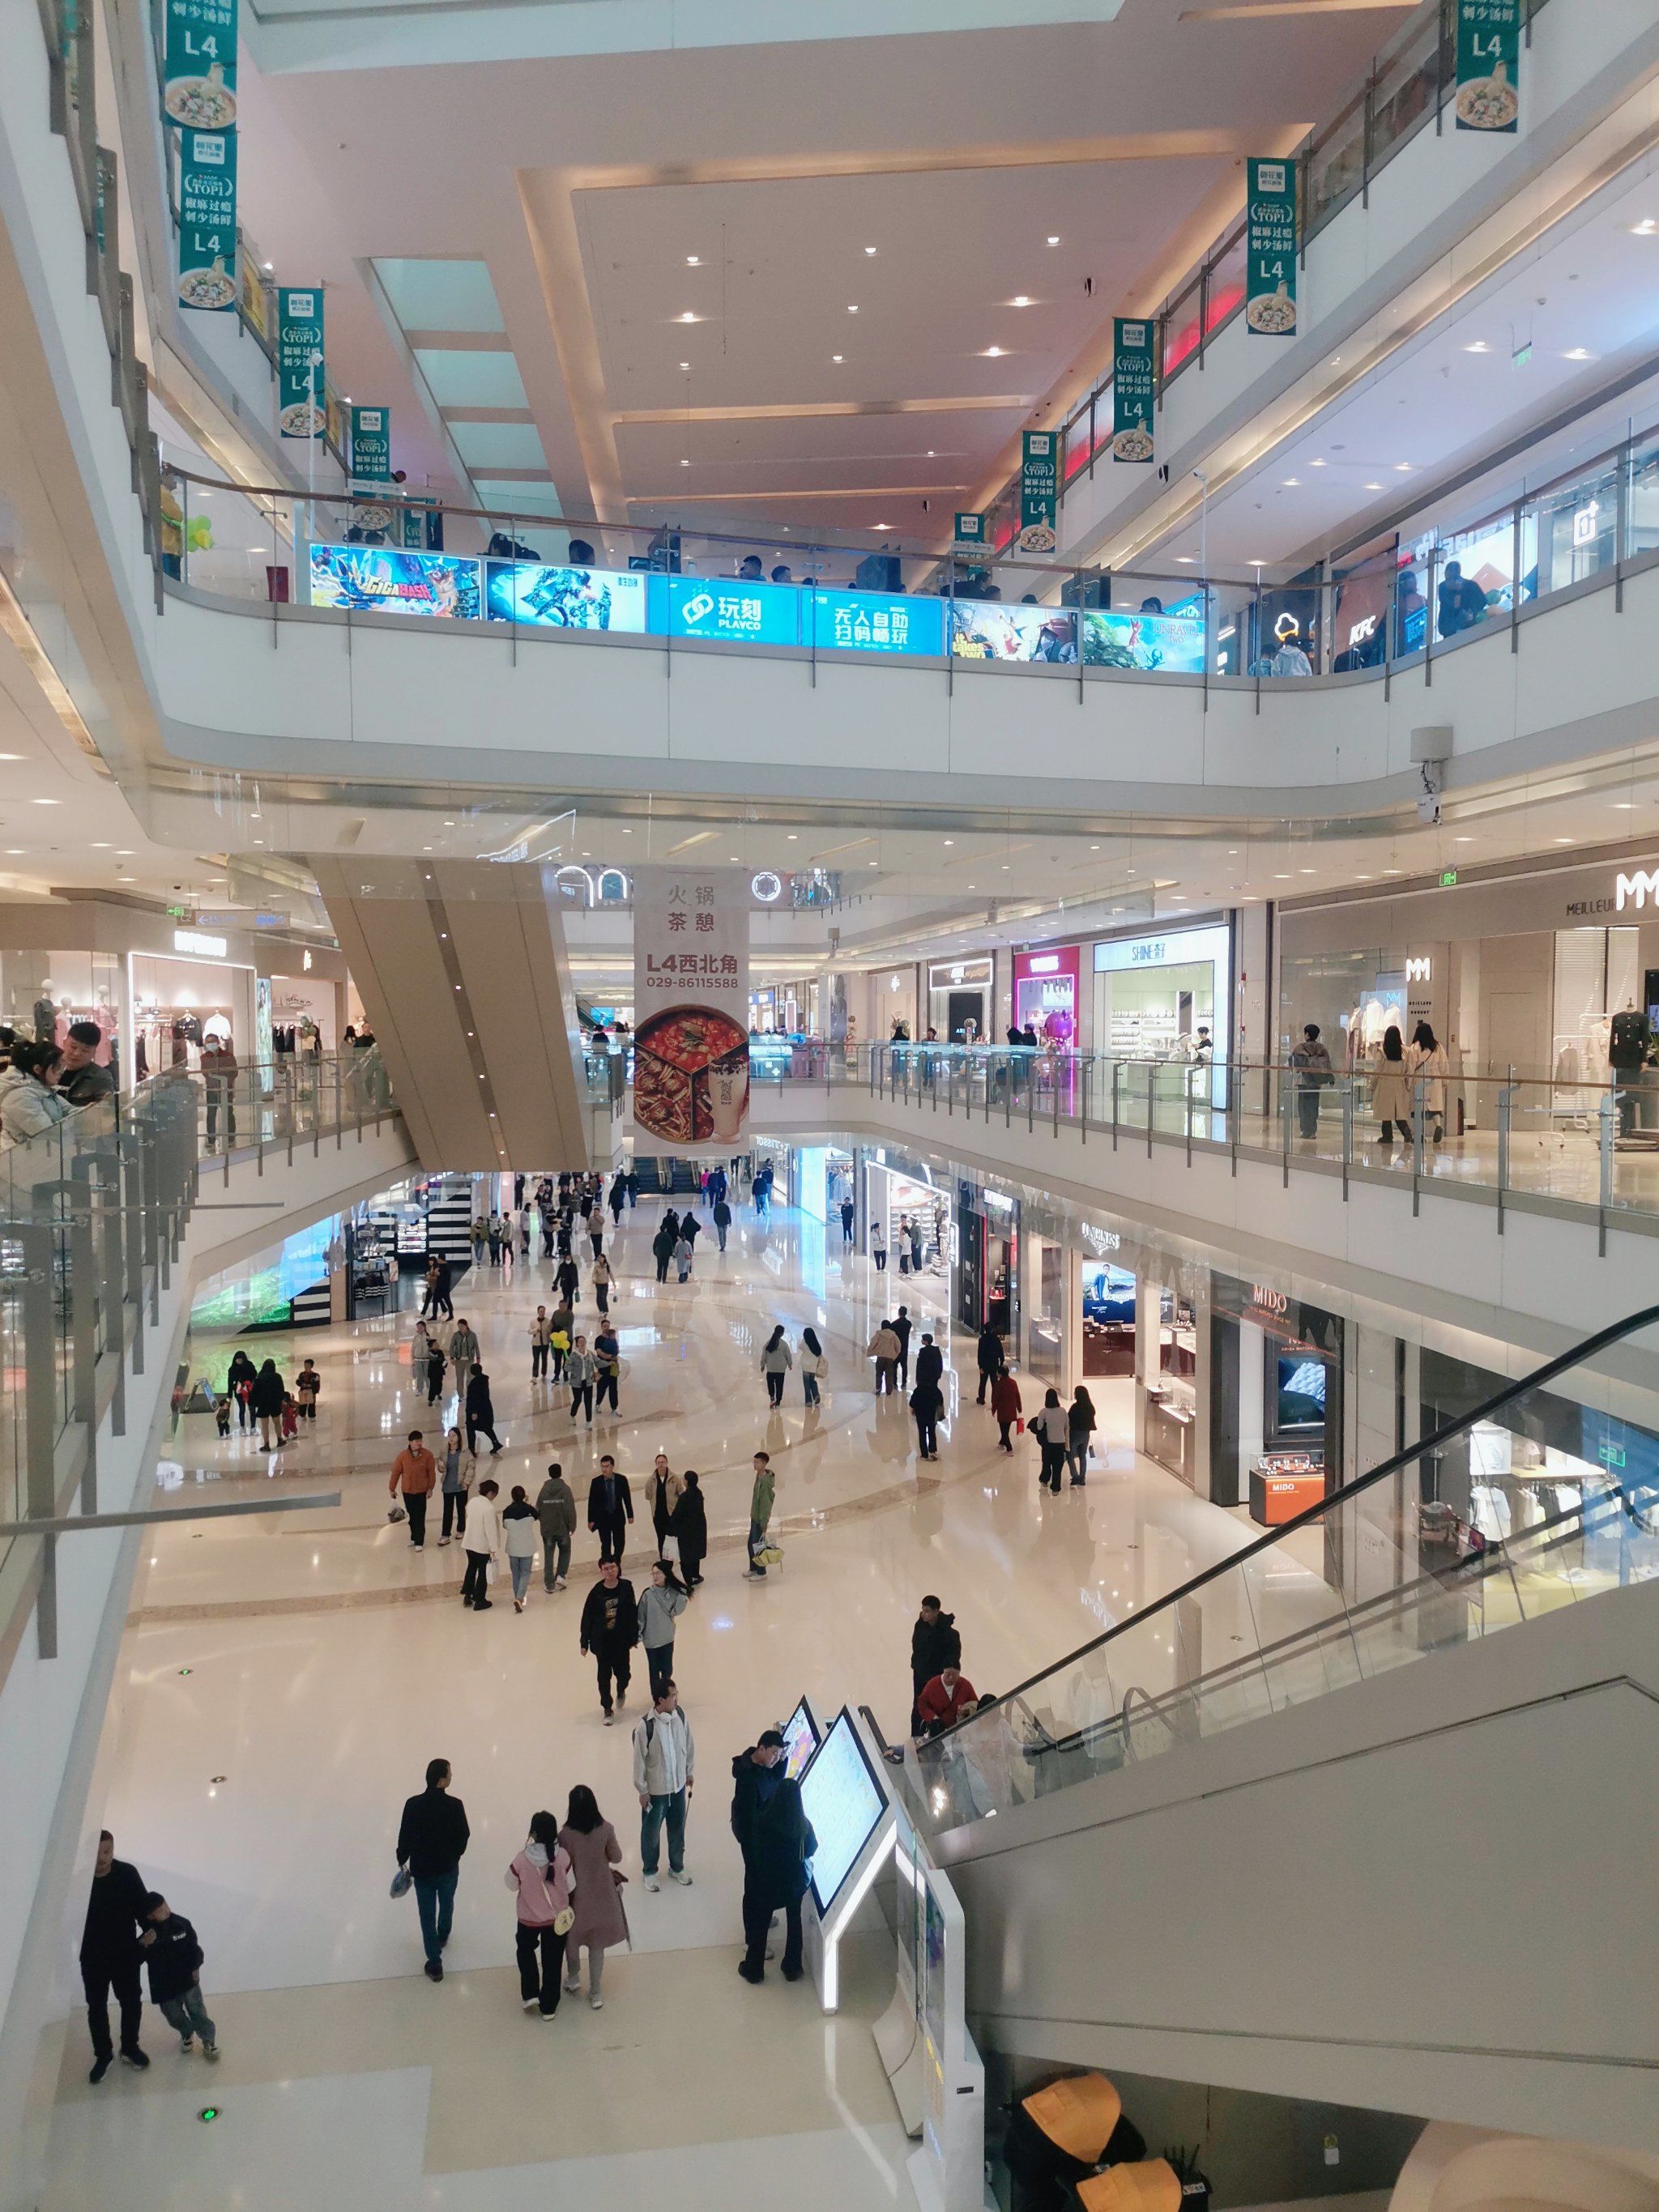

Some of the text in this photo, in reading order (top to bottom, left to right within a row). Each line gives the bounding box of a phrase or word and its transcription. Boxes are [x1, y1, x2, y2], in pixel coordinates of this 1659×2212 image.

[185, 30, 219, 58] L4
[1473, 33, 1502, 57] L4
[194, 233, 220, 253] L4
[1260, 260, 1283, 278] L4
[1124, 402, 1144, 417] L4
[1030, 501, 1047, 514] L4
[718, 596, 762, 621] 玩刻
[834, 607, 909, 629] 无人自助
[719, 619, 761, 631] PLAYCO
[1153, 623, 1201, 637] UNRAVEL
[1349, 615, 1376, 646] KFC
[834, 625, 908, 646] 扫码畅玩
[668, 884, 714, 906] 火锅
[667, 912, 714, 932] 茶憩
[646, 953, 738, 974] L4西北角
[646, 977, 738, 988] 029-86115588
[1252, 1283, 1287, 1312] MIDO
[1272, 1483, 1295, 1491] MIDO
